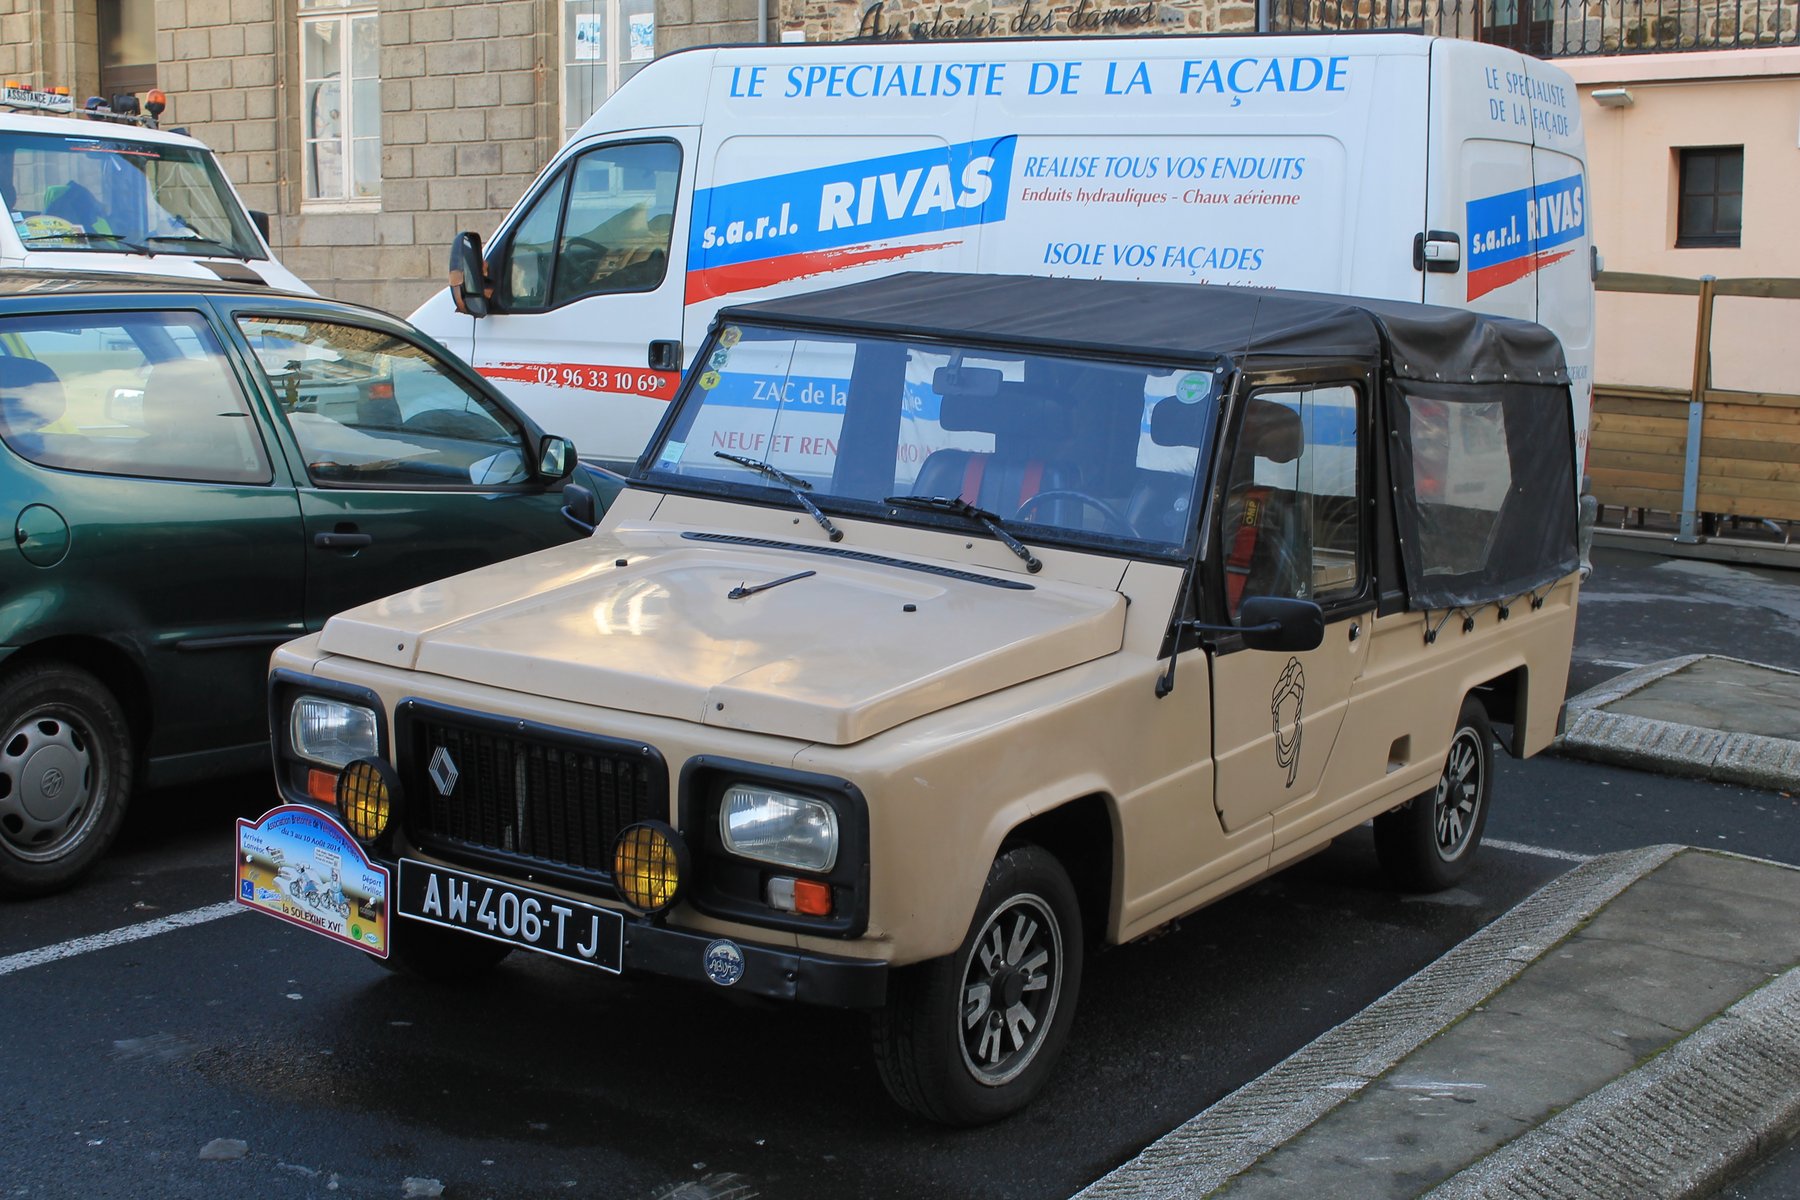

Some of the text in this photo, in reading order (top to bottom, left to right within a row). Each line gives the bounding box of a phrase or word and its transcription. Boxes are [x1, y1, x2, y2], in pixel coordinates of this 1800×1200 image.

[850, 2, 902, 40] Au
[914, 4, 1000, 39] plaisir
[1010, 0, 1056, 33] des
[729, 55, 1350, 108] LE SPECIALISTE DE LA FAÇADE
[1485, 66, 1567, 108] LE SPECIALISTE
[7, 89, 47, 105] ASSISTANCE
[1489, 98, 1569, 140] DE LA FAÇADE
[1023, 156, 1306, 181] REALISE TOUS VOS ENDUITS
[701, 155, 996, 250] s.a.r.l. RIVAS
[1021, 187, 1073, 203] Enduits
[1076, 188, 1168, 207] hydrauliques
[1182, 189, 1230, 205] Chaux
[1233, 189, 1301, 206] aérienne
[1472, 186, 1583, 255] s.a.r.l. RIVAS
[1043, 242, 1265, 276] ISOLE VOS FAÇADES
[537, 367, 658, 392] 02 96 33 10 69
[752, 380, 796, 403] ZAC
[800, 379, 825, 406] de
[831, 384, 848, 407] la
[711, 430, 766, 452] NEUF
[771, 435, 794, 453] ET
[1245, 500, 1257, 525] OMP
[243, 832, 263, 844] Arrivée
[281, 827, 289, 836] du
[294, 832, 303, 840] au
[303, 834, 311, 843] 10
[310, 838, 326, 848] Août
[327, 842, 341, 853] 2014
[362, 874, 382, 888] Départ
[282, 903, 289, 914] la
[290, 907, 326, 928] SOLEXINE
